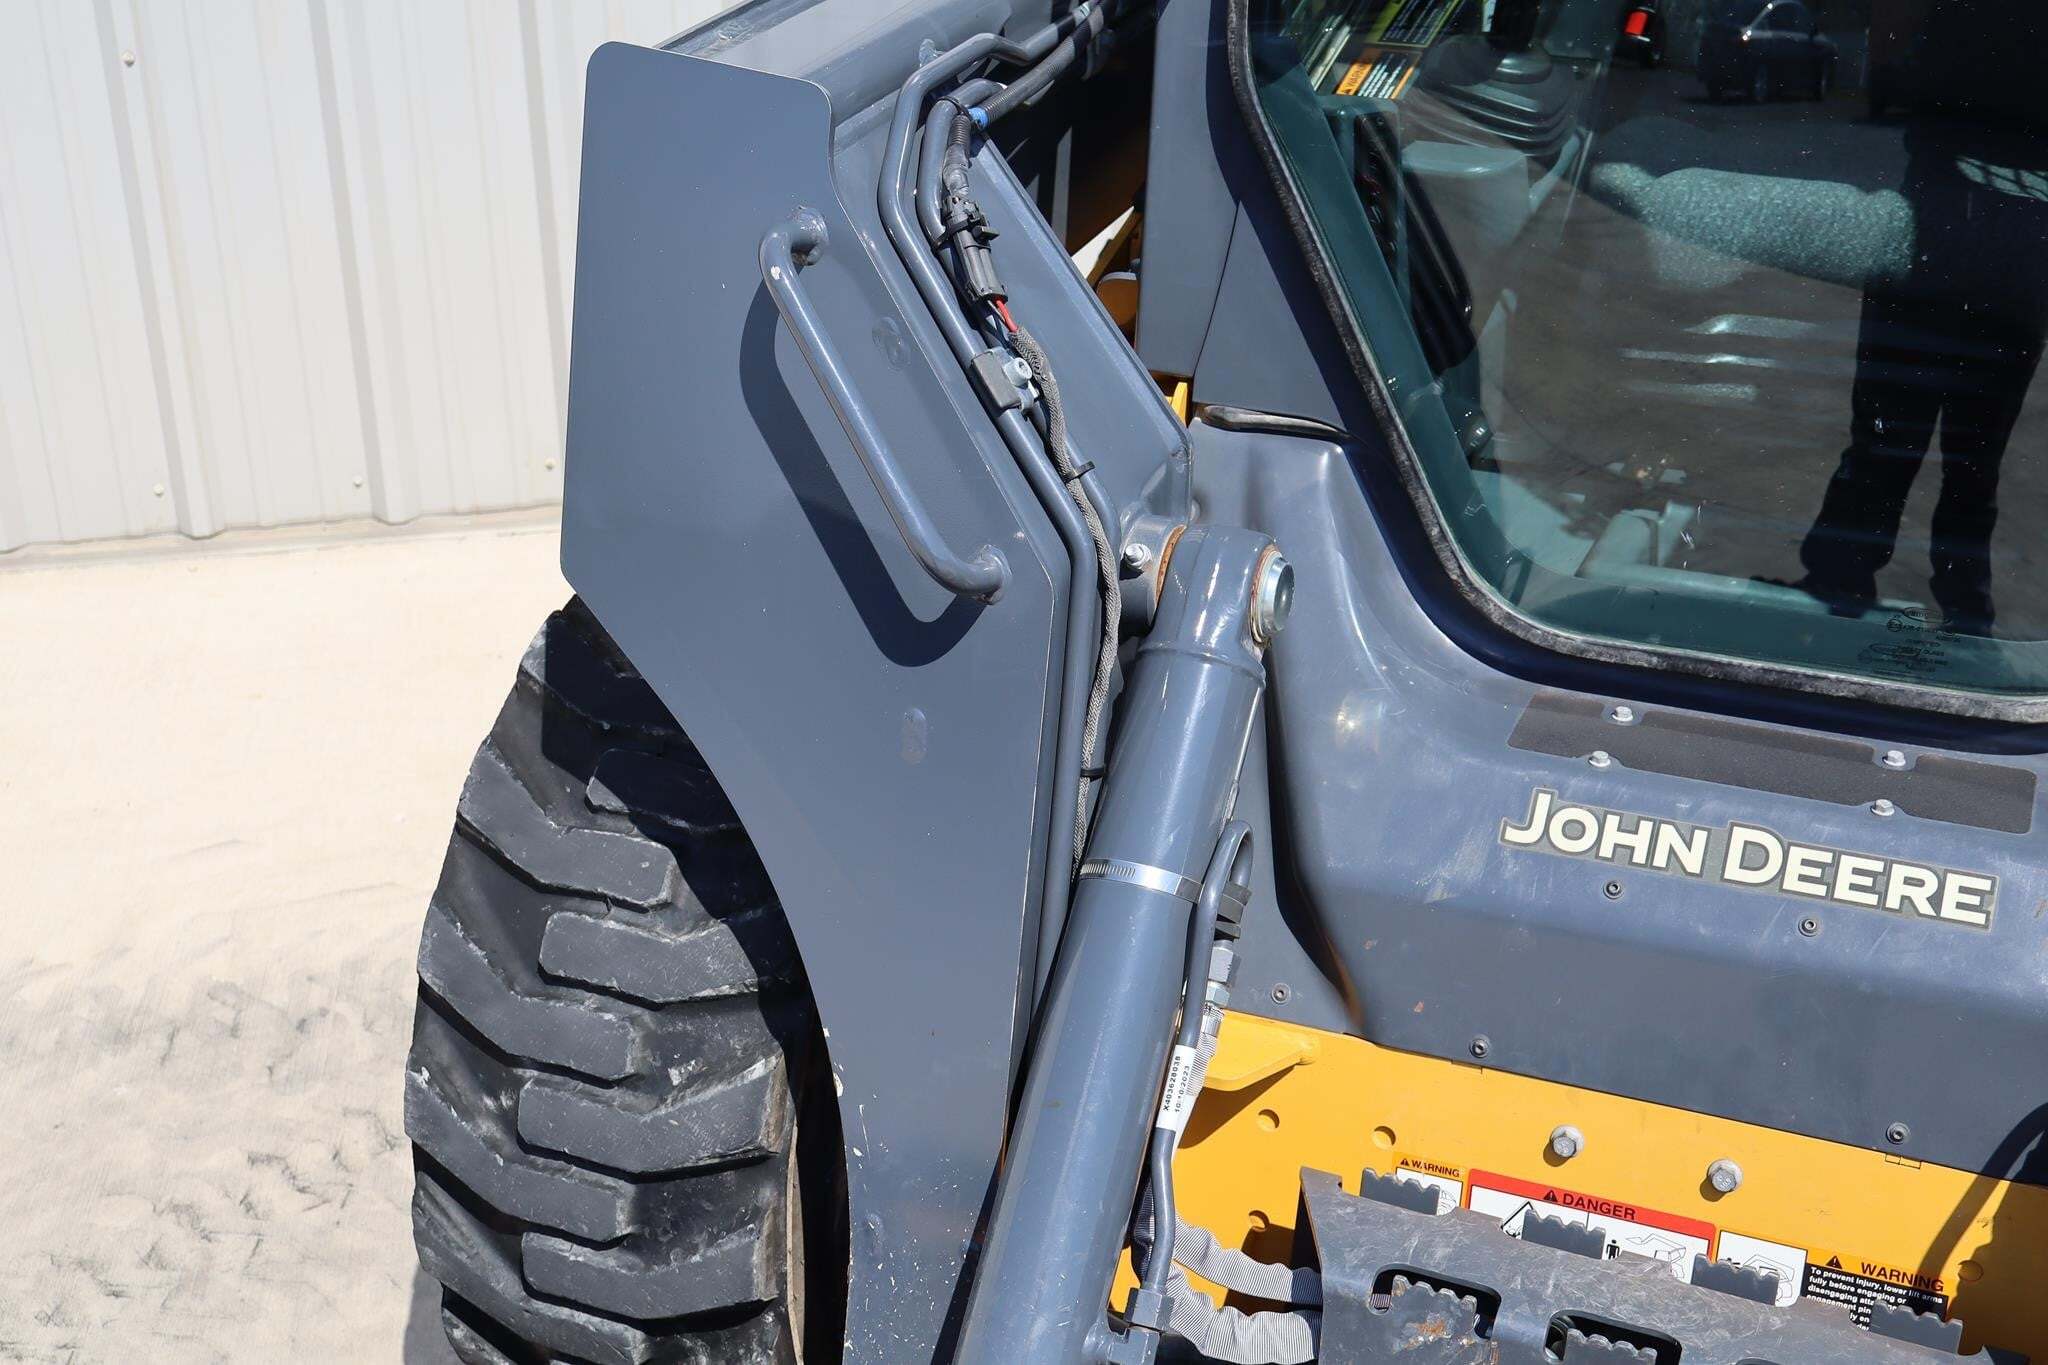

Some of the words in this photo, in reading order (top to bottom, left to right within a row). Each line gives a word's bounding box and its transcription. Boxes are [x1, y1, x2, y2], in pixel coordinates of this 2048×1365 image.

[1503, 792, 1708, 878] JOHN
[1722, 824, 1993, 926] DEERE
[1411, 1158, 1460, 1178] WARNING
[1562, 1193, 1637, 1221] DANGER
[1809, 1275, 1828, 1287] fully
[1828, 1280, 1856, 1292] before
[1857, 1288, 1896, 1303] engaging
[1811, 1266, 1822, 1275] To
[1823, 1271, 1855, 1283] prevent
[1884, 1284, 1907, 1296] lower
[1909, 1289, 1921, 1298] lift
[1922, 1294, 1943, 1304] arms
[1861, 1261, 1945, 1293] WARNING
[1808, 1284, 1858, 1303] disengaging
